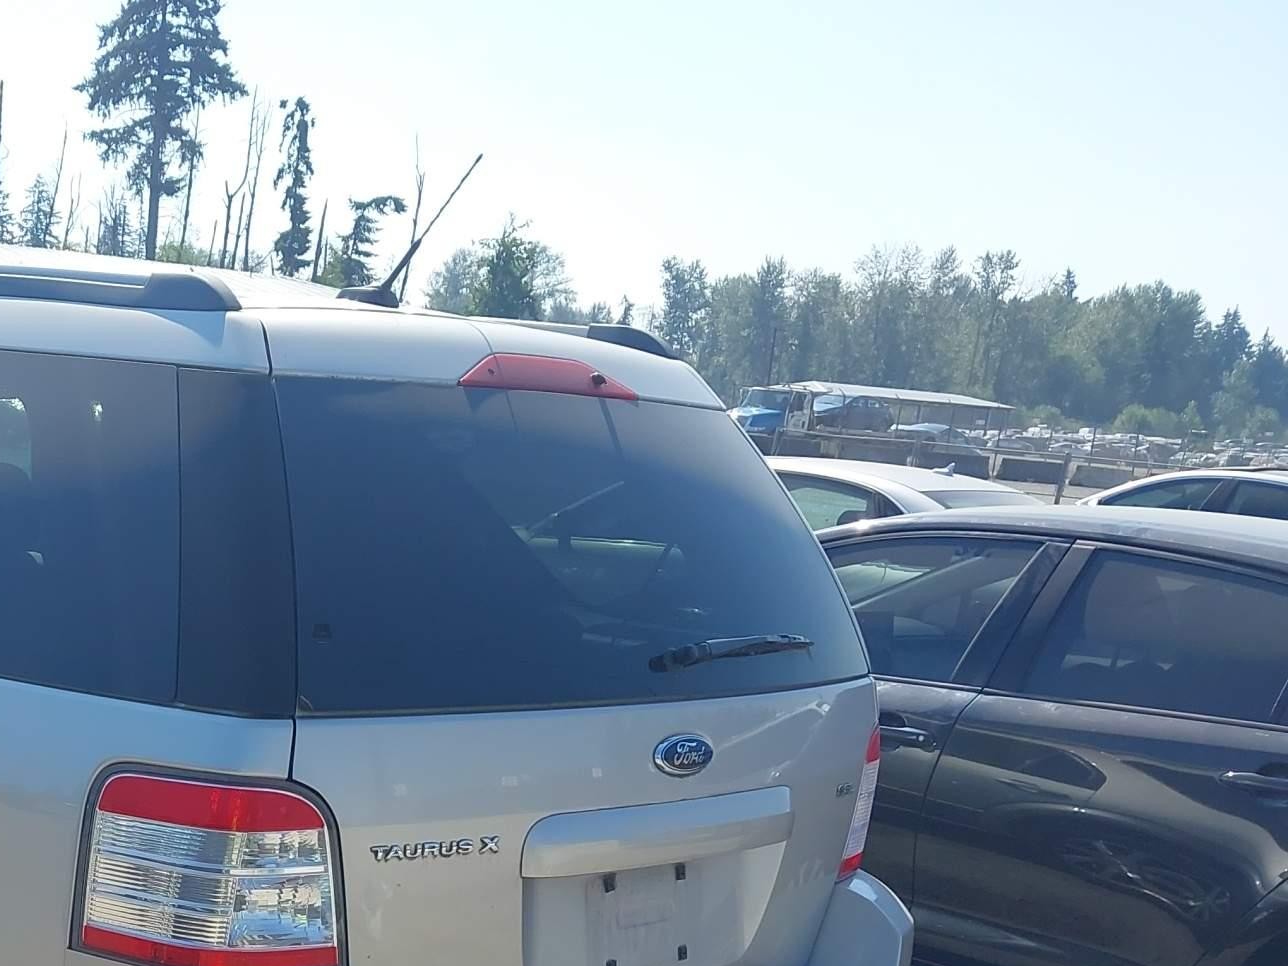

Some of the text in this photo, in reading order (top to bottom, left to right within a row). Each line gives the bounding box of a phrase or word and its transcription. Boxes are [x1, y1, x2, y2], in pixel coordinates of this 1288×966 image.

[673, 741, 705, 766] Ford
[370, 835, 500, 862] TAURUS X
